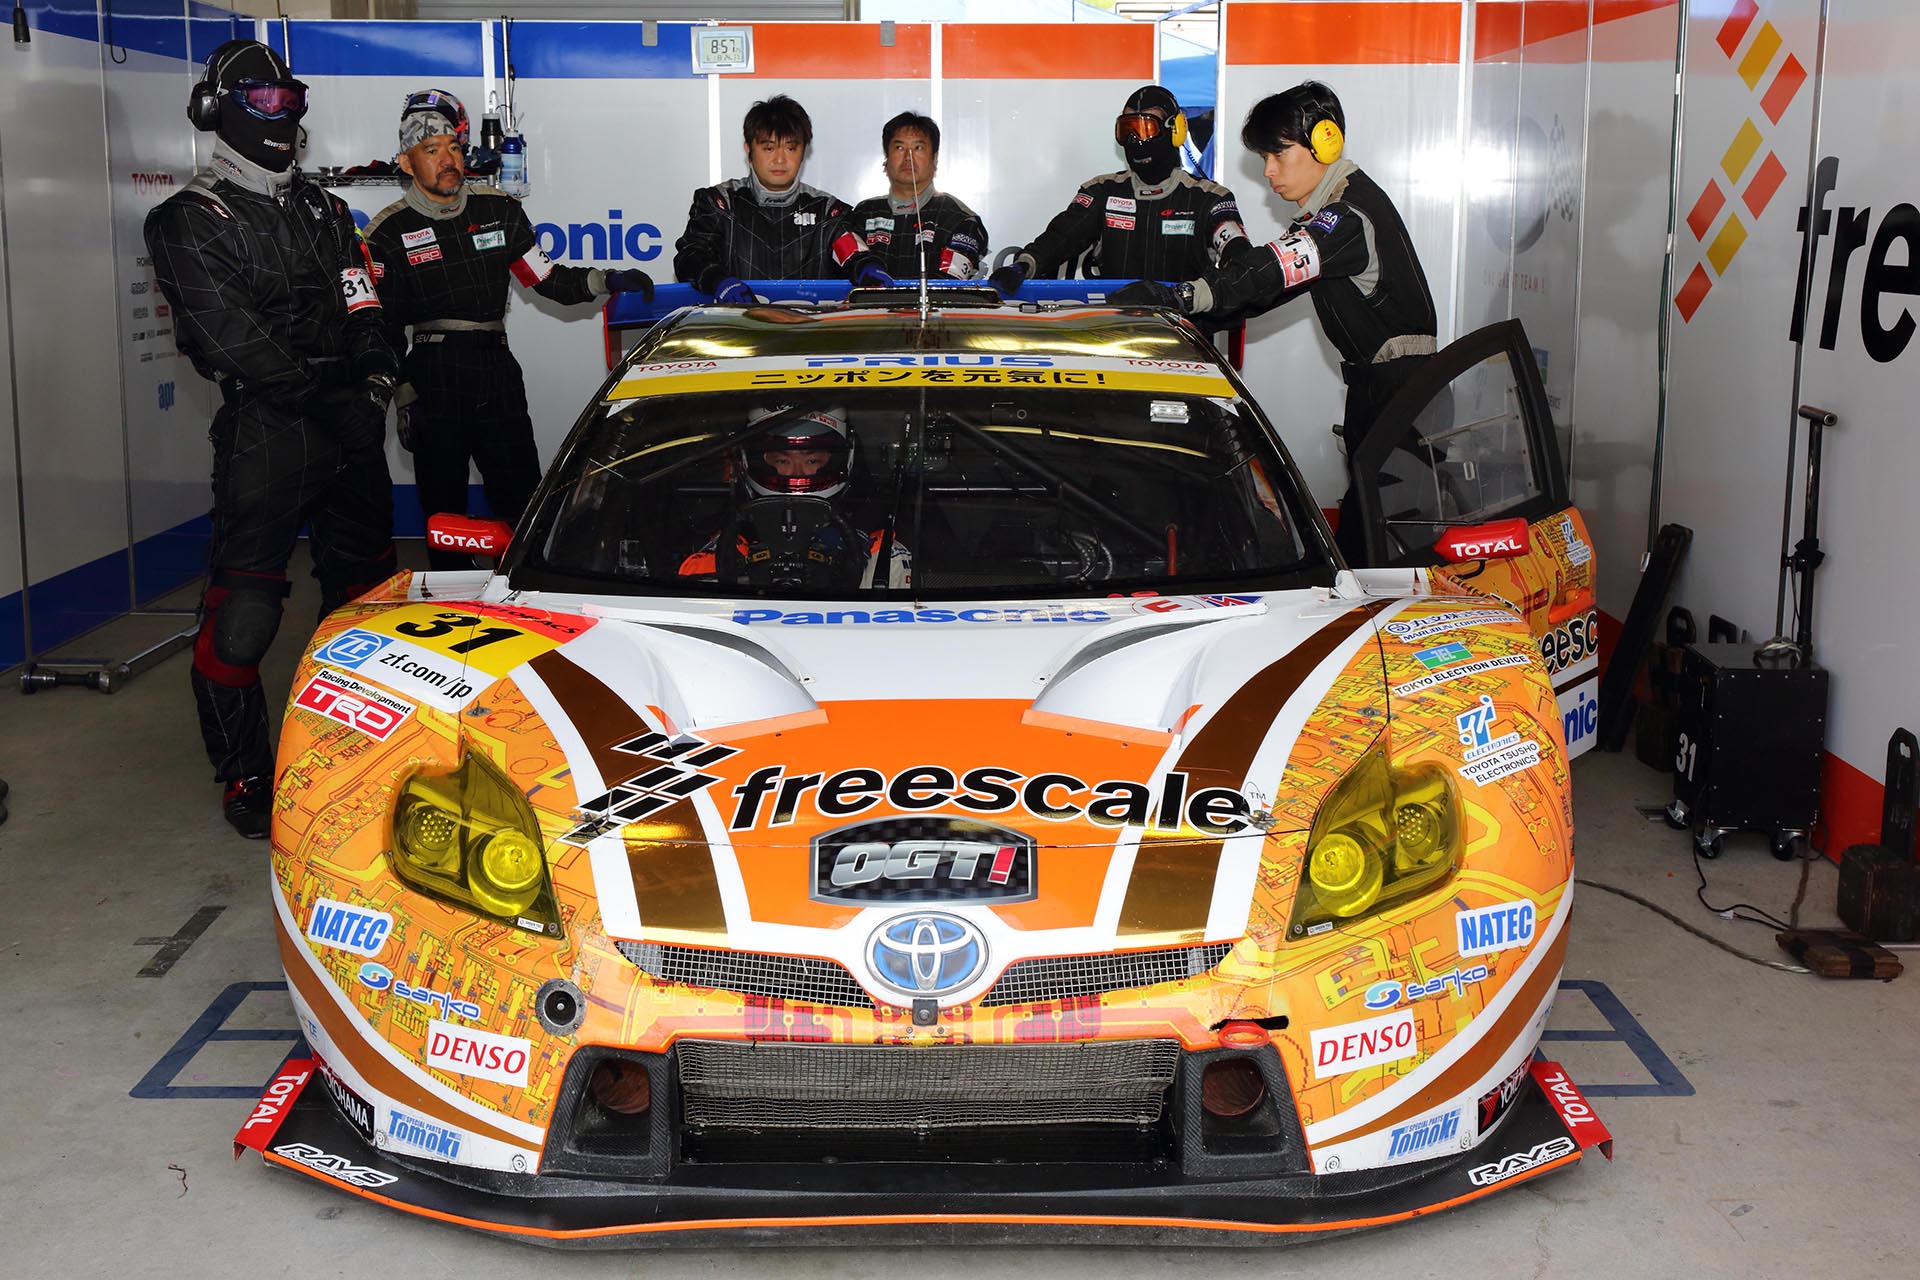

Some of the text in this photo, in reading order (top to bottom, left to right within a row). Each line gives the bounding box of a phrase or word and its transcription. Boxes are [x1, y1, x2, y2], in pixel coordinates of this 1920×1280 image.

[131, 173, 175, 194] TOYOTA
[794, 211, 816, 226] apr
[1109, 198, 1133, 206] TOYOTA
[404, 230, 430, 240] TOYOTA
[1107, 218, 1134, 229] TRD
[410, 250, 440, 263] TRD
[638, 361, 718, 372] TOYOTA
[804, 356, 1054, 368] PRIUS
[1125, 359, 1208, 370] TOYOTA
[430, 530, 493, 549] TOTAL
[1450, 538, 1523, 557] TOTAL
[732, 604, 1112, 625] Panasonic
[1454, 616, 1520, 631] CORPORATION
[395, 613, 525, 654] 31
[379, 653, 473, 700] zf.com/jp
[1395, 655, 1528, 695] TOKYO ELECTRON DEVICE
[312, 683, 394, 728] TRD
[319, 670, 412, 715] Racing Development
[1463, 743, 1537, 776] TOYOTA TSUSHO
[1466, 734, 1519, 760] ELECTRONICS
[1676, 733, 1697, 782] 31
[1475, 754, 1538, 783] ELECTRONICS
[730, 767, 1251, 834] freescale
[311, 905, 388, 951] NATEC
[1460, 905, 1533, 951] NATEC
[1407, 966, 1487, 996] sanko
[395, 982, 480, 1020] sanko
[430, 1032, 526, 1074] DENSO
[1318, 1021, 1412, 1067] DENSO
[244, 1071, 309, 1129] TOTAL
[1544, 1071, 1595, 1128] TOTAL
[388, 1110, 461, 1159] Tomoki
[407, 1116, 441, 1134] SPECIAL PARTS
[1388, 1110, 1460, 1158] Tomoki
[1428, 1114, 1443, 1126] PARTS
[279, 1145, 391, 1184] RAYS
[1474, 1139, 1572, 1183] RAYS
[1486, 1150, 1569, 1183] ENGINEERING
